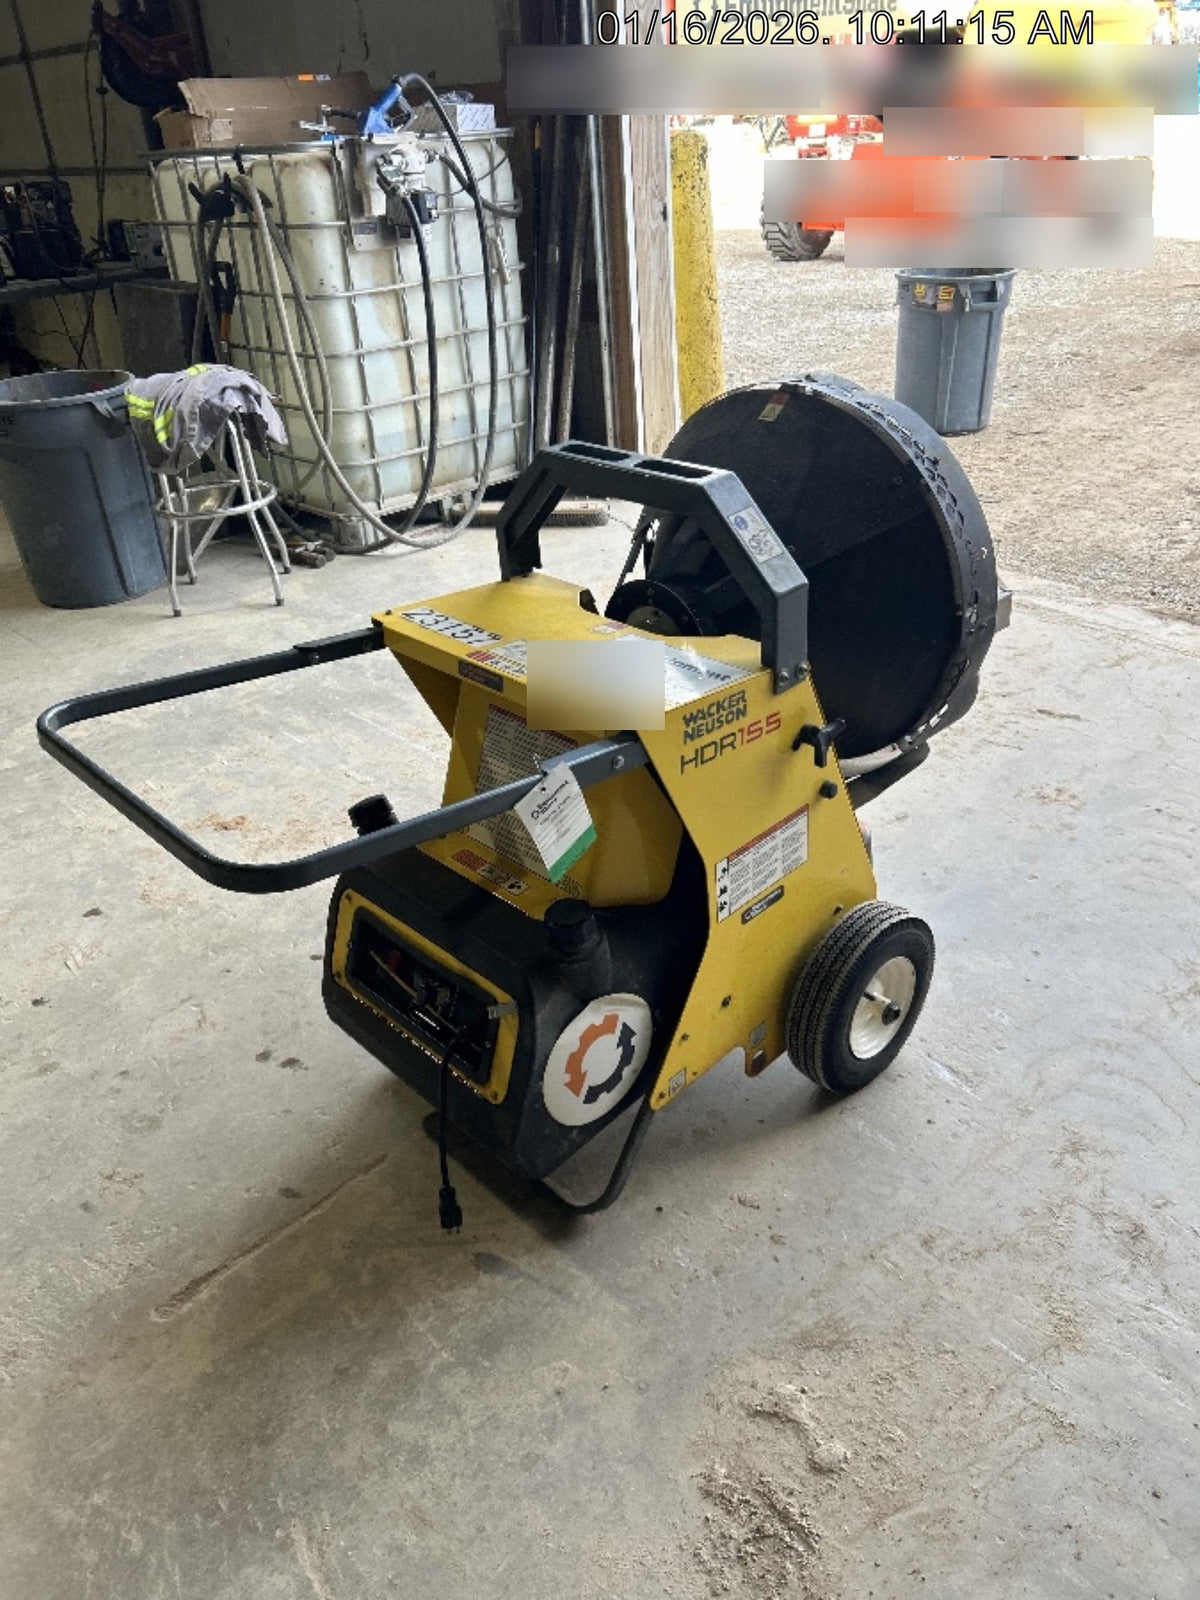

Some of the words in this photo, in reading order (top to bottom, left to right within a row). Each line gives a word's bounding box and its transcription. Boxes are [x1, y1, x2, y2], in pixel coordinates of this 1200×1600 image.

[682, 690, 748, 728] WACKER
[683, 704, 748, 745] NEUSON
[680, 711, 782, 775] HDR155
